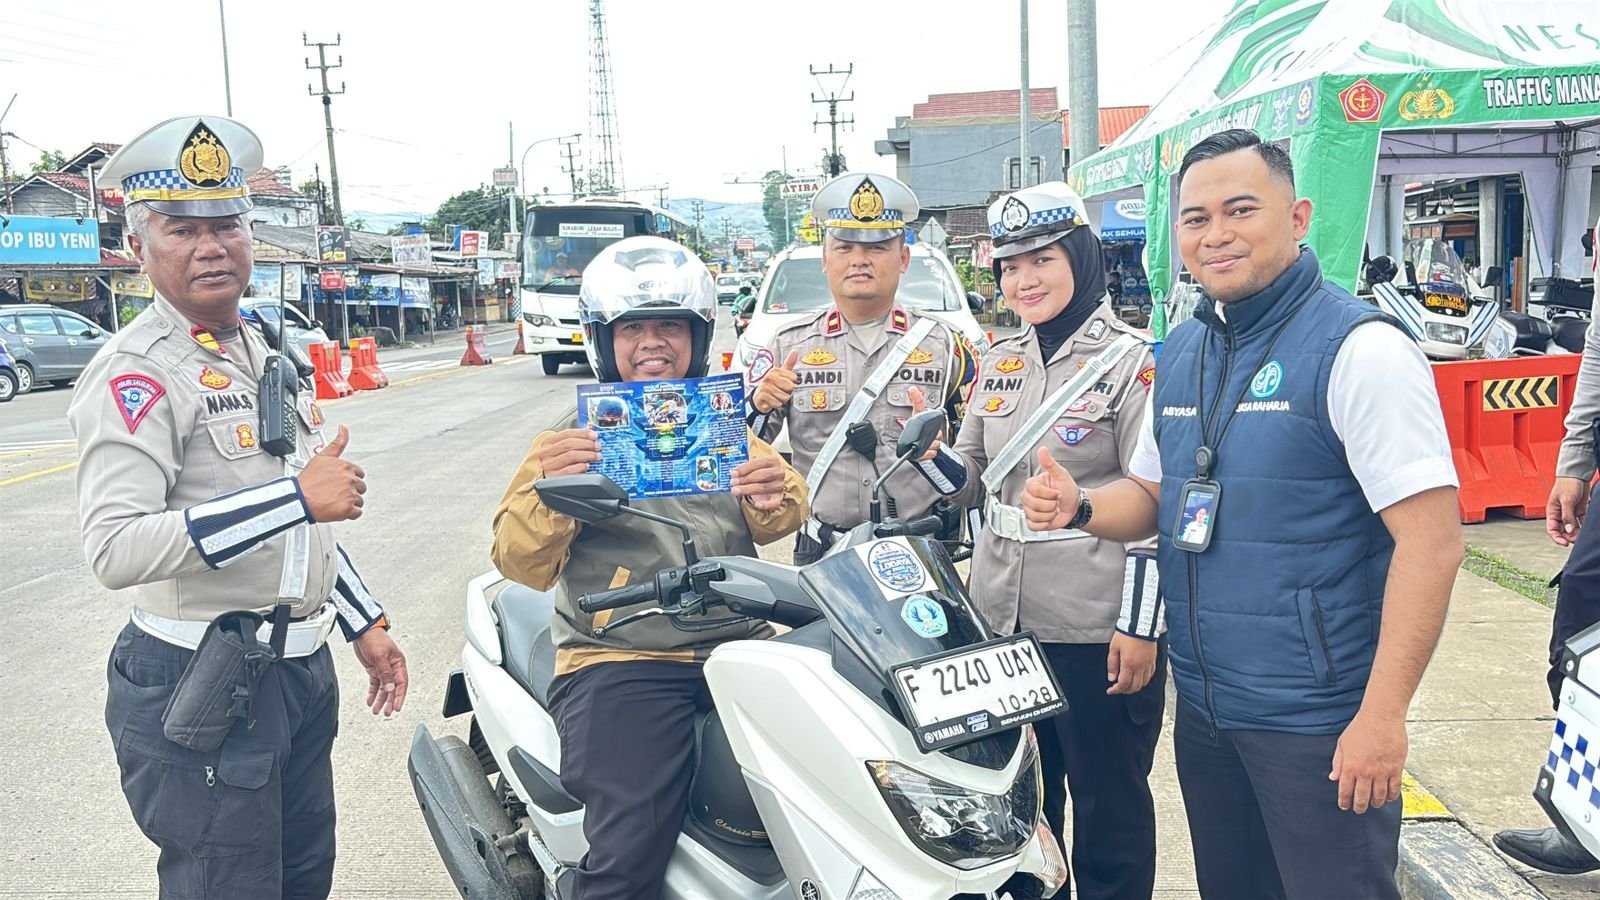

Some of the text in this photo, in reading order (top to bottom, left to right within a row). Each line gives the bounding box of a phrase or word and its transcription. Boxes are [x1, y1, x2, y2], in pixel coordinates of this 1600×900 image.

[1483, 77, 1553, 108] TRAFFIC
[1120, 203, 1146, 211] AQUA
[1114, 229, 1146, 237] SEMUA
[28, 232, 56, 249] IBU
[60, 233, 95, 249] YENI
[796, 371, 842, 385] SANDI
[983, 378, 1023, 391] RANI
[1162, 406, 1197, 417] ABYASA
[1252, 400, 1290, 411] RAHARJA
[903, 646, 1038, 703] F 2240 UAY
[932, 723, 966, 741] YAMAHA
